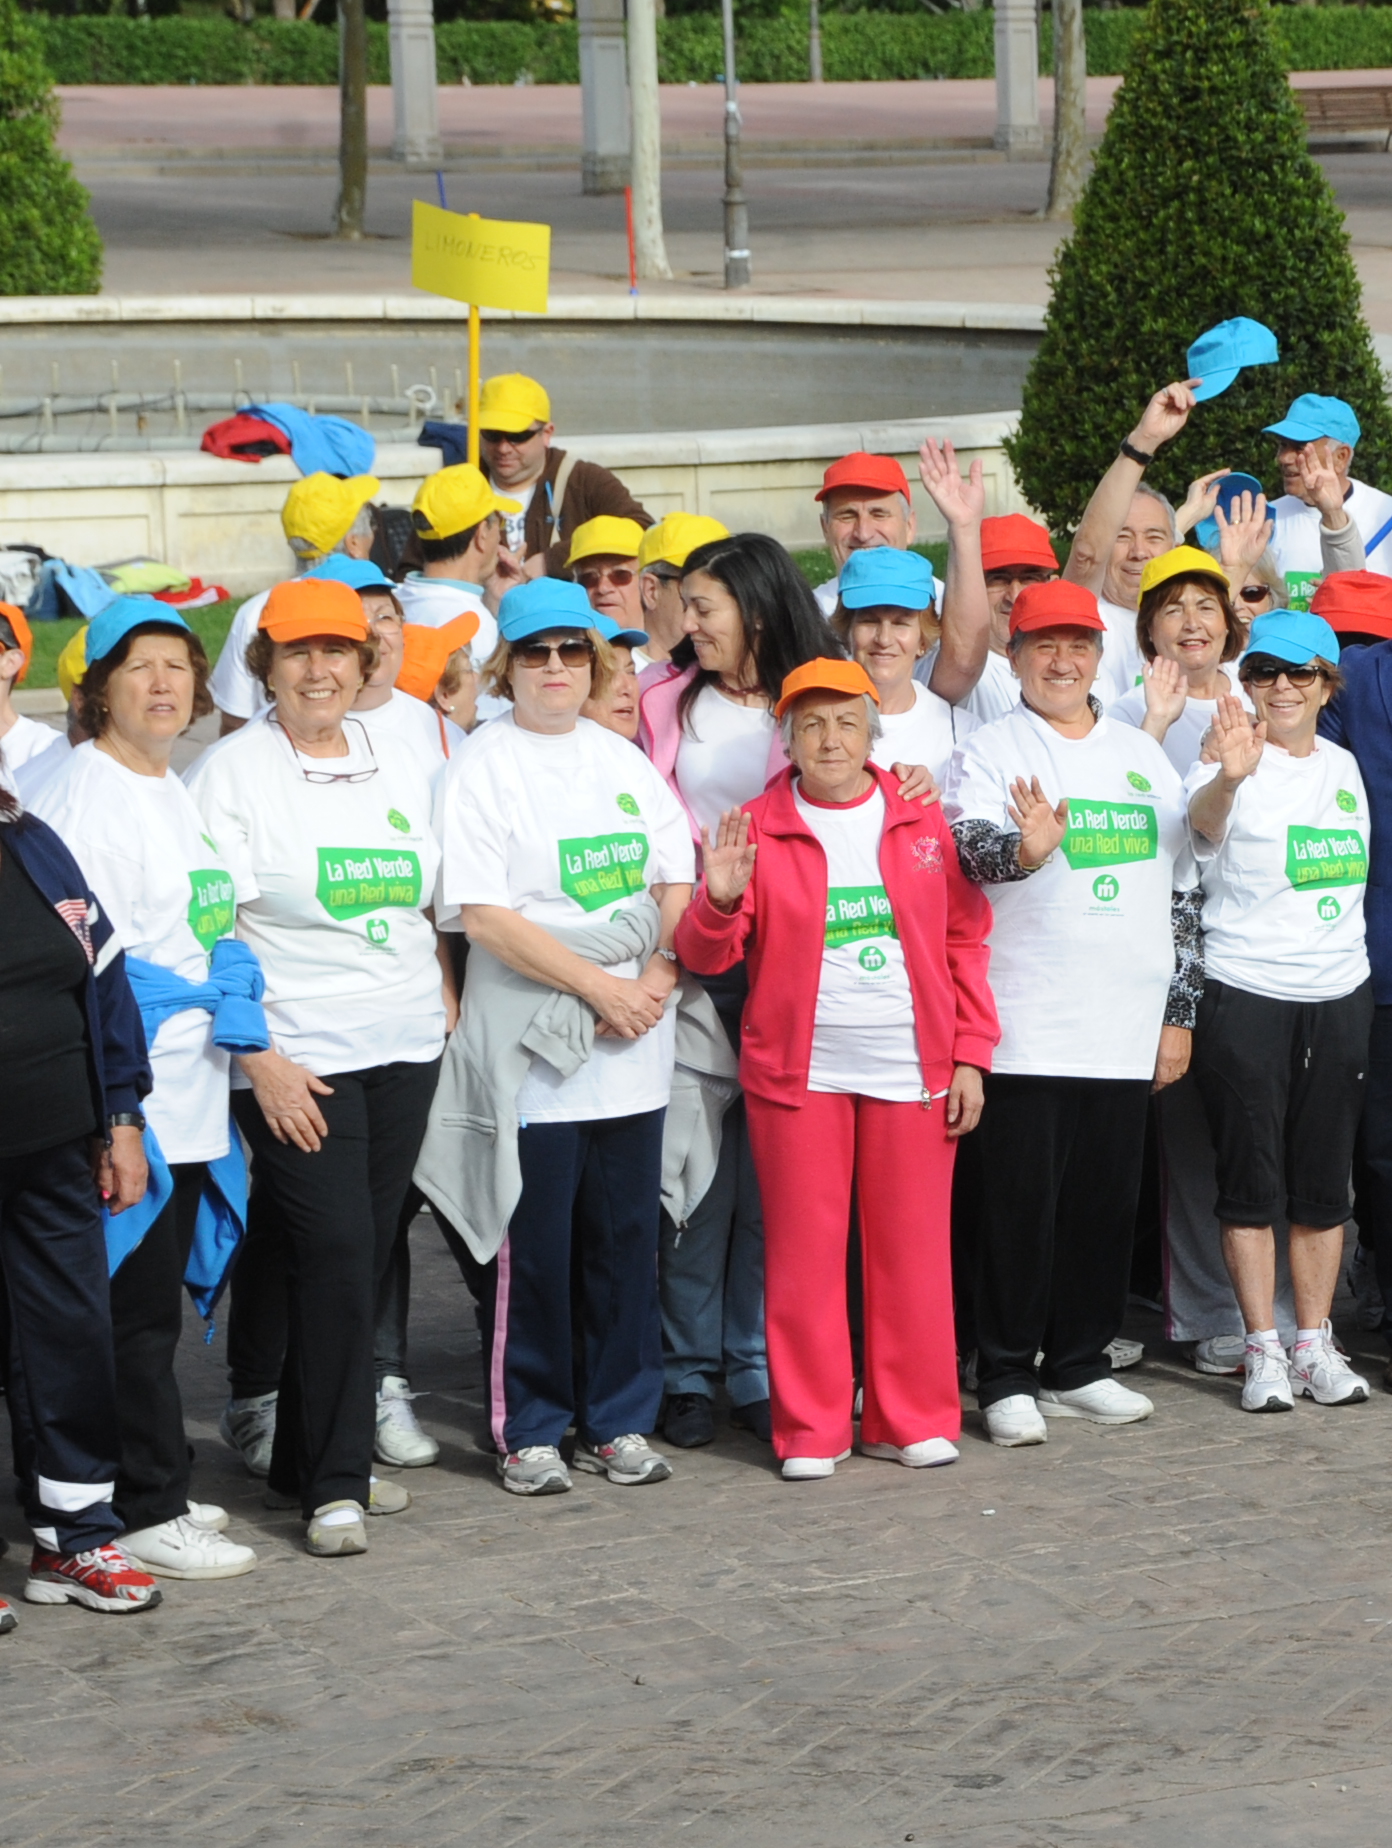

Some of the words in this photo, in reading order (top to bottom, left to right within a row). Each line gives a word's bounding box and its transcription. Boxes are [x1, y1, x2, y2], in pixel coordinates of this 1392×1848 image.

[425, 230, 547, 271] LIMONEROS
[1300, 580, 1316, 597] Re
[1068, 809, 1084, 830] La
[1084, 809, 1108, 830] Red
[1110, 809, 1149, 831] Verde
[1070, 836, 1093, 854] una
[1096, 833, 1120, 854] Red
[1123, 833, 1150, 854] viva
[1293, 840, 1308, 860] La
[1306, 838, 1330, 859] Red
[1328, 835, 1362, 857] Verde
[325, 860, 345, 882] La
[344, 857, 374, 880] Red
[373, 855, 414, 879] Verde
[565, 853, 583, 875] La
[584, 844, 611, 871] Red
[610, 838, 644, 863] Verde
[574, 878, 600, 897] una
[597, 866, 624, 890] Red
[1296, 866, 1319, 883] una
[1320, 859, 1344, 879] Red
[197, 885, 209, 908] La
[329, 886, 357, 907] una
[359, 882, 386, 904] Red
[388, 881, 414, 903] viva
[838, 896, 867, 920] Red
[852, 918, 880, 936] Red
